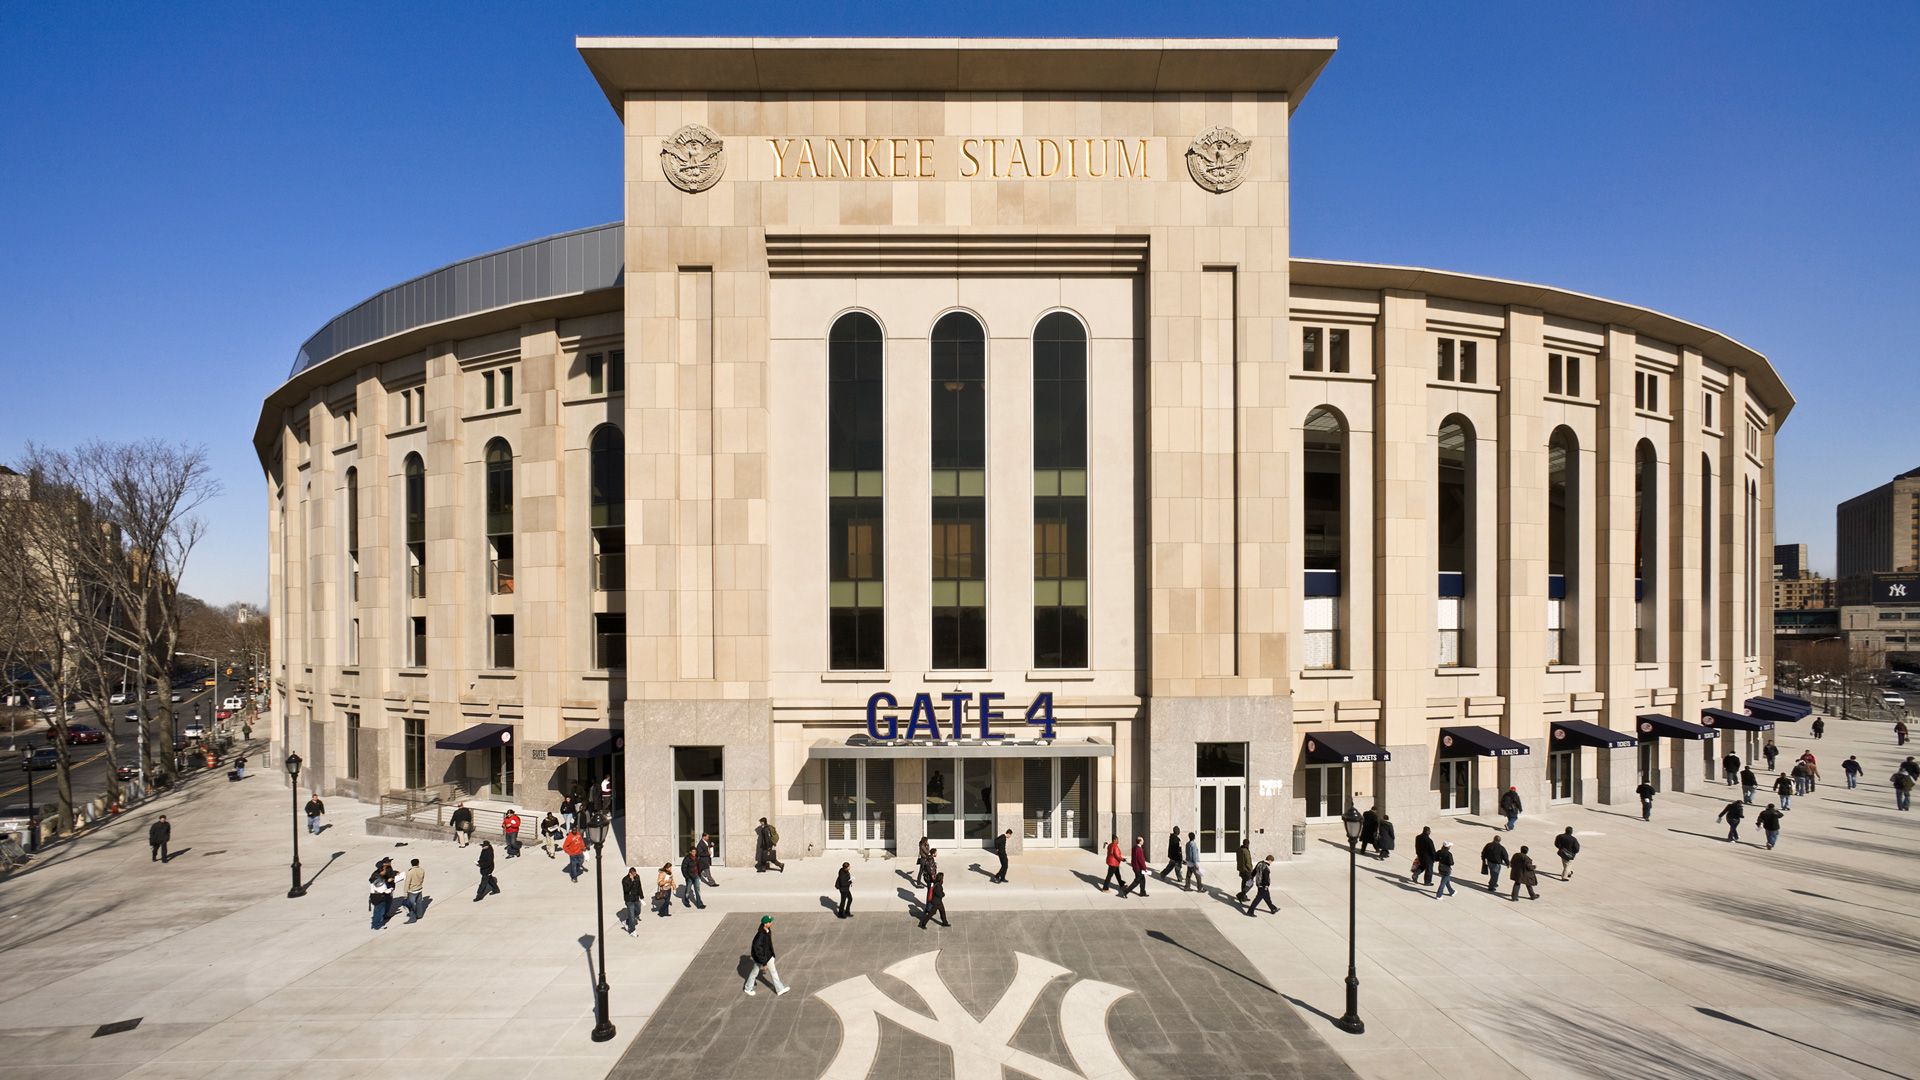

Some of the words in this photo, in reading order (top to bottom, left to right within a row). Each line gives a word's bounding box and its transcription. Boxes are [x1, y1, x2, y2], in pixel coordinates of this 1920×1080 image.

[766, 138, 936, 178] YANKEE
[959, 138, 1151, 178] STADIUM
[866, 691, 1005, 741] GATE
[1024, 691, 1057, 740] 4
[1355, 754, 1377, 762] TICKETS
